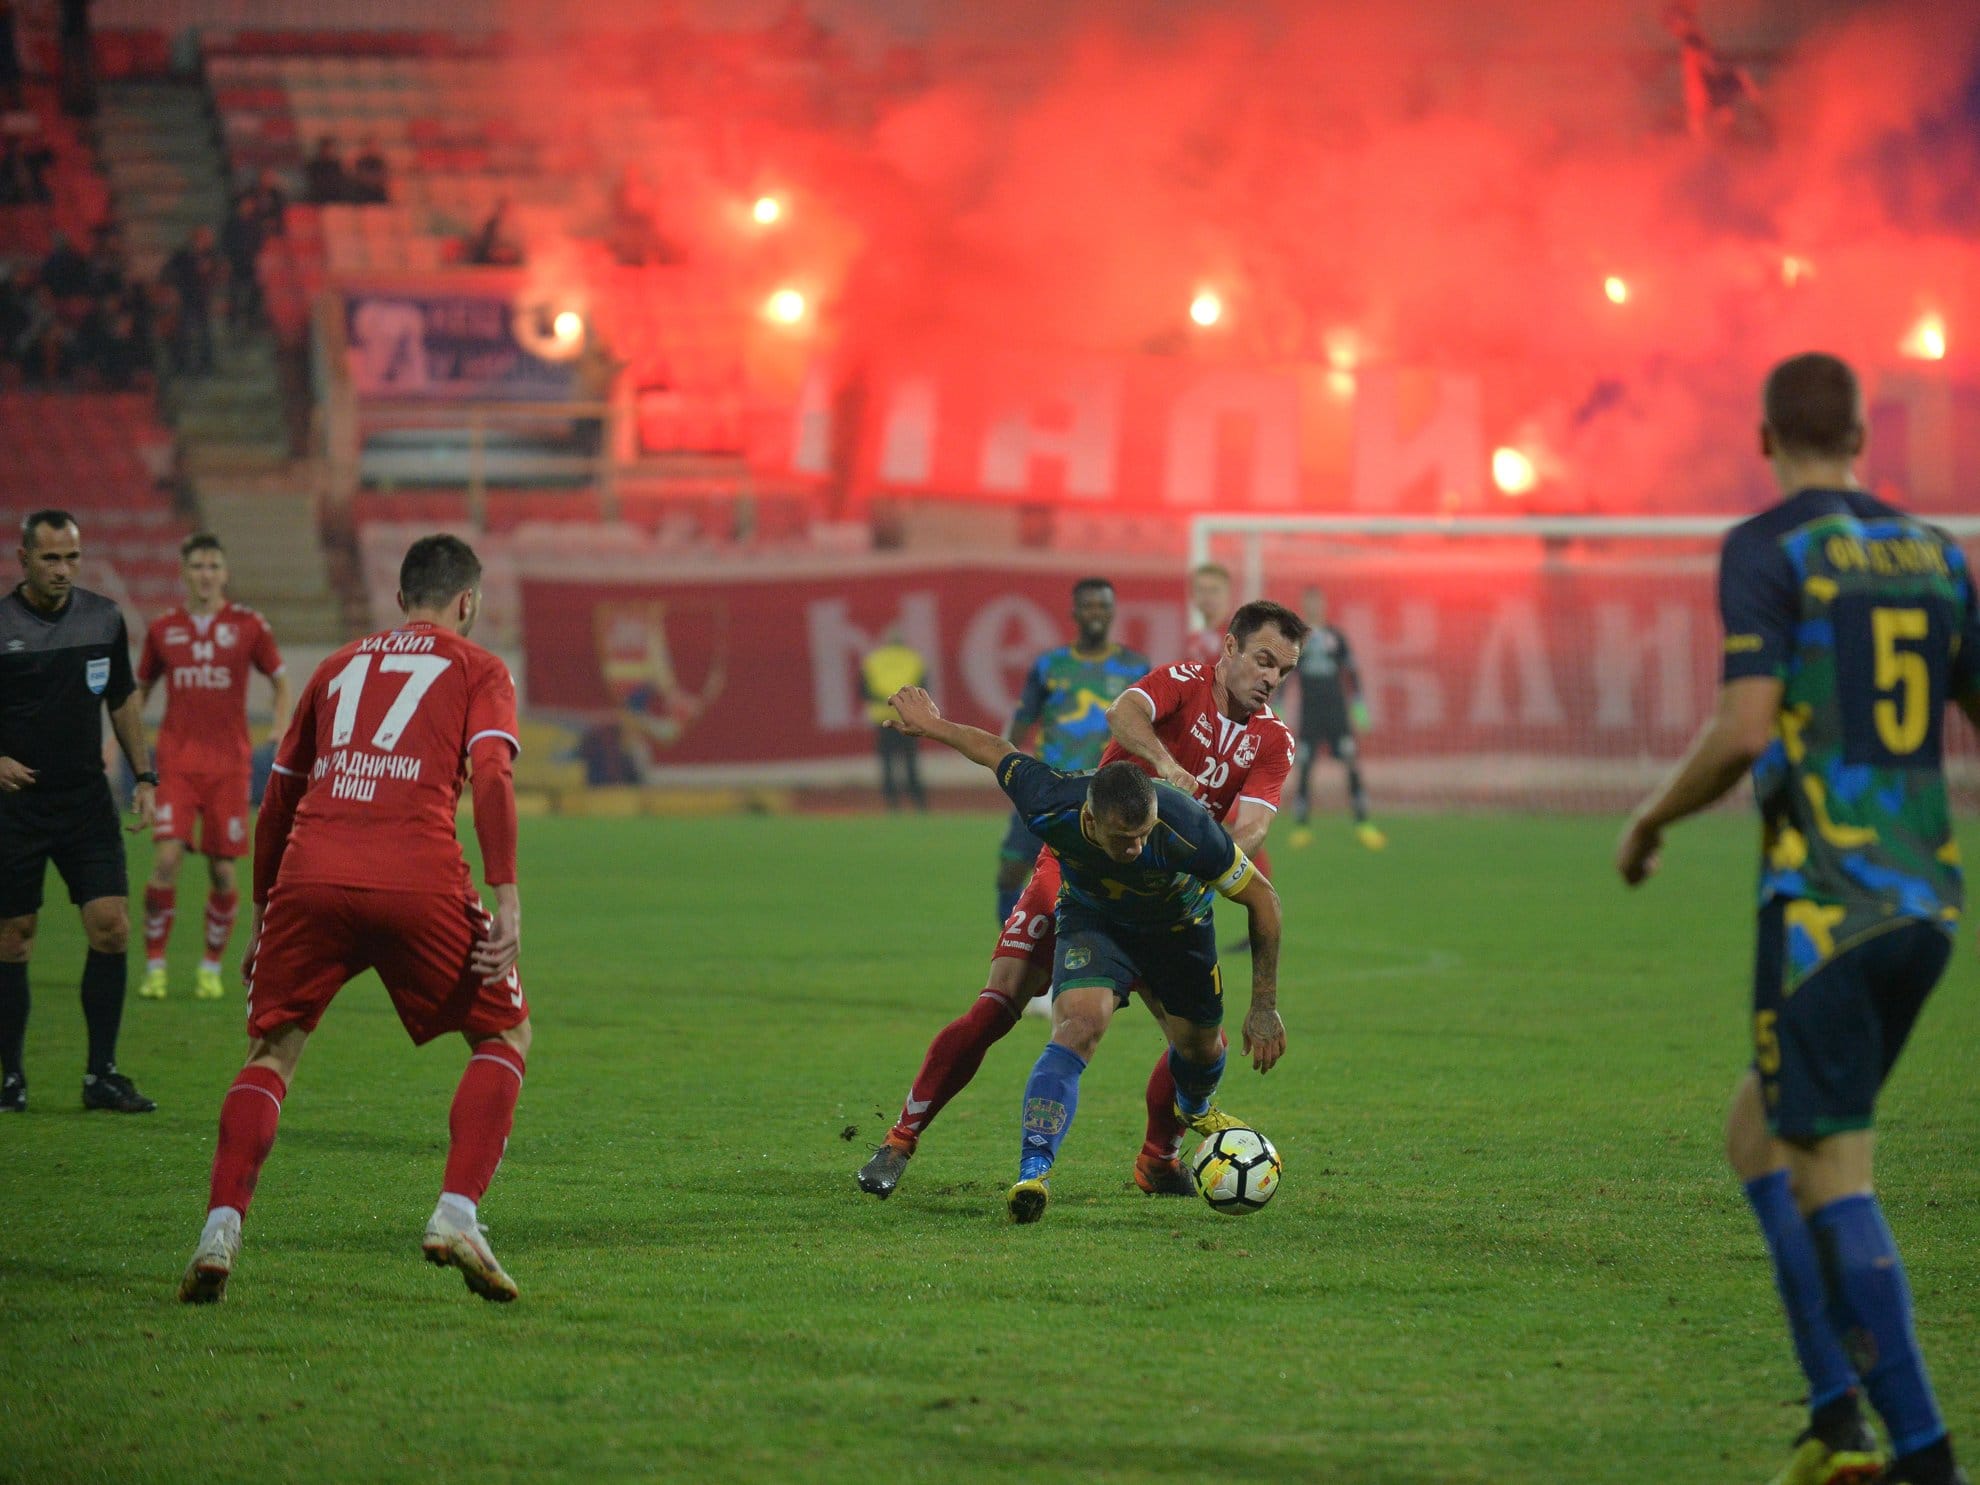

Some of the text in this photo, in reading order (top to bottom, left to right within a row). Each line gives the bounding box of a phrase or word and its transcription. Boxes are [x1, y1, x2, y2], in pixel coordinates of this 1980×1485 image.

[172, 663, 233, 690] mts
[1871, 606, 1930, 756] 5
[326, 653, 452, 753] 17
[1195, 756, 1230, 789] 20
[331, 774, 377, 803] НИШ
[1006, 910, 1049, 939] 20
[1001, 938, 1036, 952] hummel
